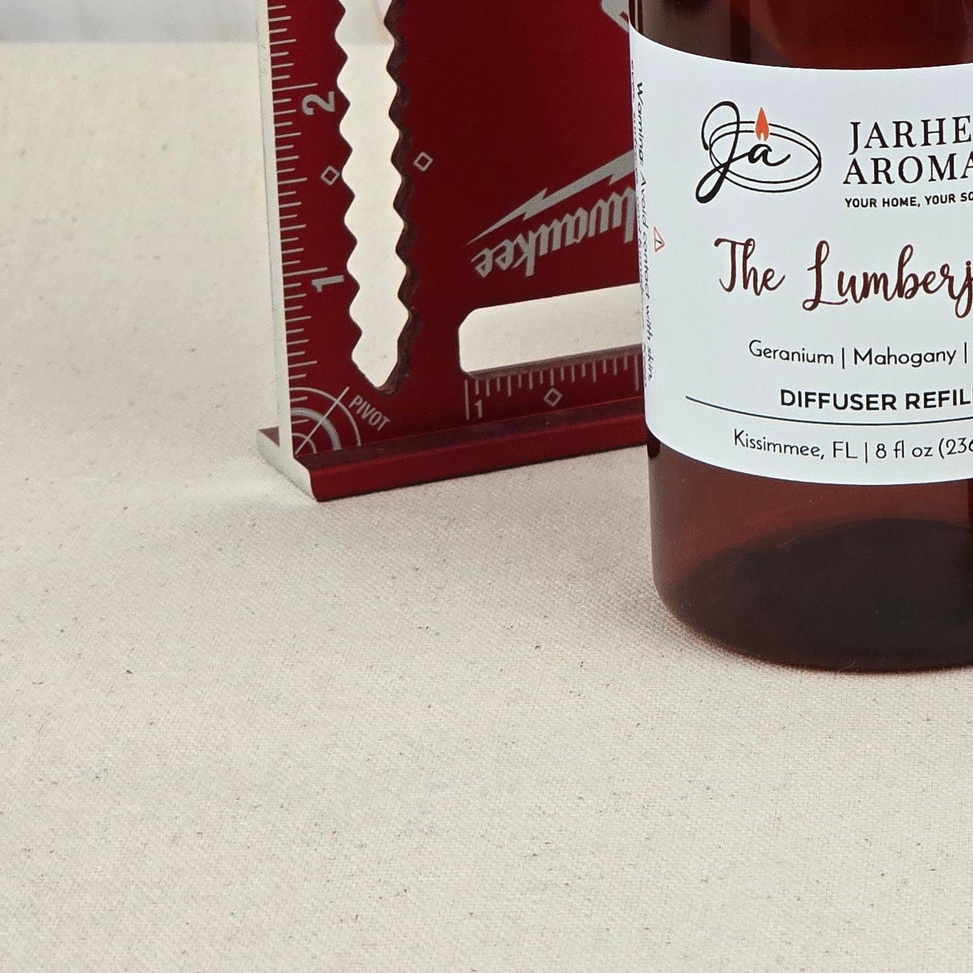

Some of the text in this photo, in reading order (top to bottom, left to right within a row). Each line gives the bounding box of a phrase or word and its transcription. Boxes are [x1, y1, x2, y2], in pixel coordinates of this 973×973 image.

[302, 91, 334, 115] 2
[640, 171, 650, 229] Avoid
[844, 197, 878, 208] YOUR
[882, 196, 921, 208] HOME,
[924, 193, 956, 206] YOUR
[470, 186, 636, 278] lwaukee
[642, 231, 651, 300] contact
[714, 238, 785, 296] The
[312, 274, 344, 293] 1
[646, 305, 654, 341] with
[748, 339, 834, 365] Geranium
[853, 346, 957, 368] Mahogany
[349, 394, 390, 431] PIVOT
[474, 400, 483, 418] 1
[781, 389, 896, 410] DIFFUSER
[734, 428, 825, 460] Kissimmee,
[832, 440, 858, 459] FL
[875, 443, 887, 459] 8
[893, 439, 905, 459] fl
[911, 446, 934, 458] oz
